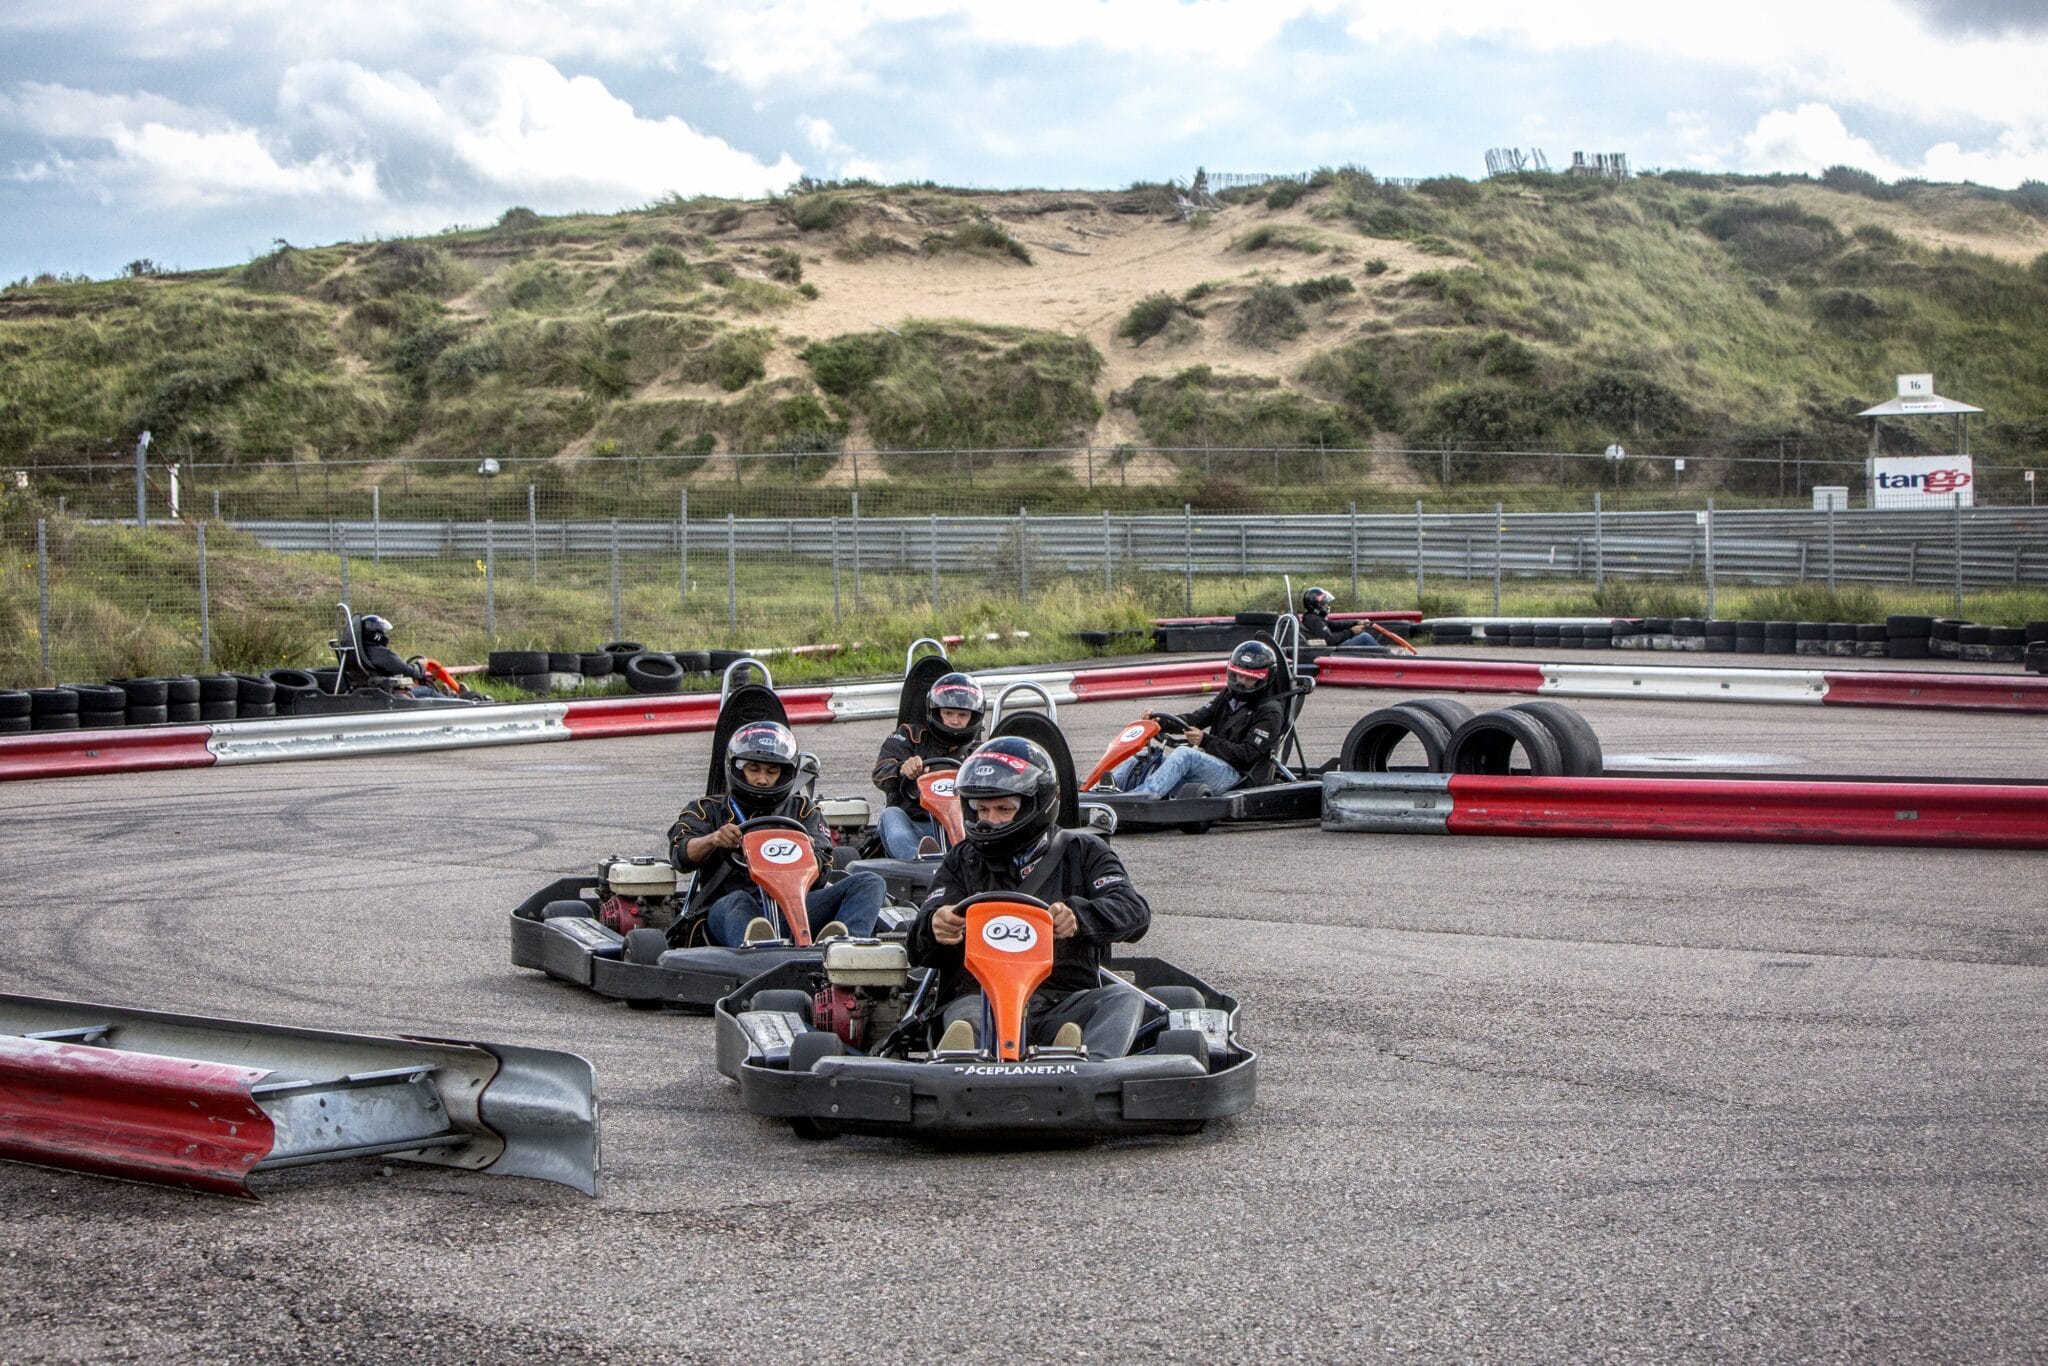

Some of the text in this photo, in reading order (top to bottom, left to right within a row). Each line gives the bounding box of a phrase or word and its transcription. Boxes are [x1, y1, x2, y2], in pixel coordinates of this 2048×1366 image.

[1910, 381, 1921, 390] 16
[1875, 469, 1971, 494] tango
[764, 844, 797, 857] 07
[986, 923, 1030, 942] 04
